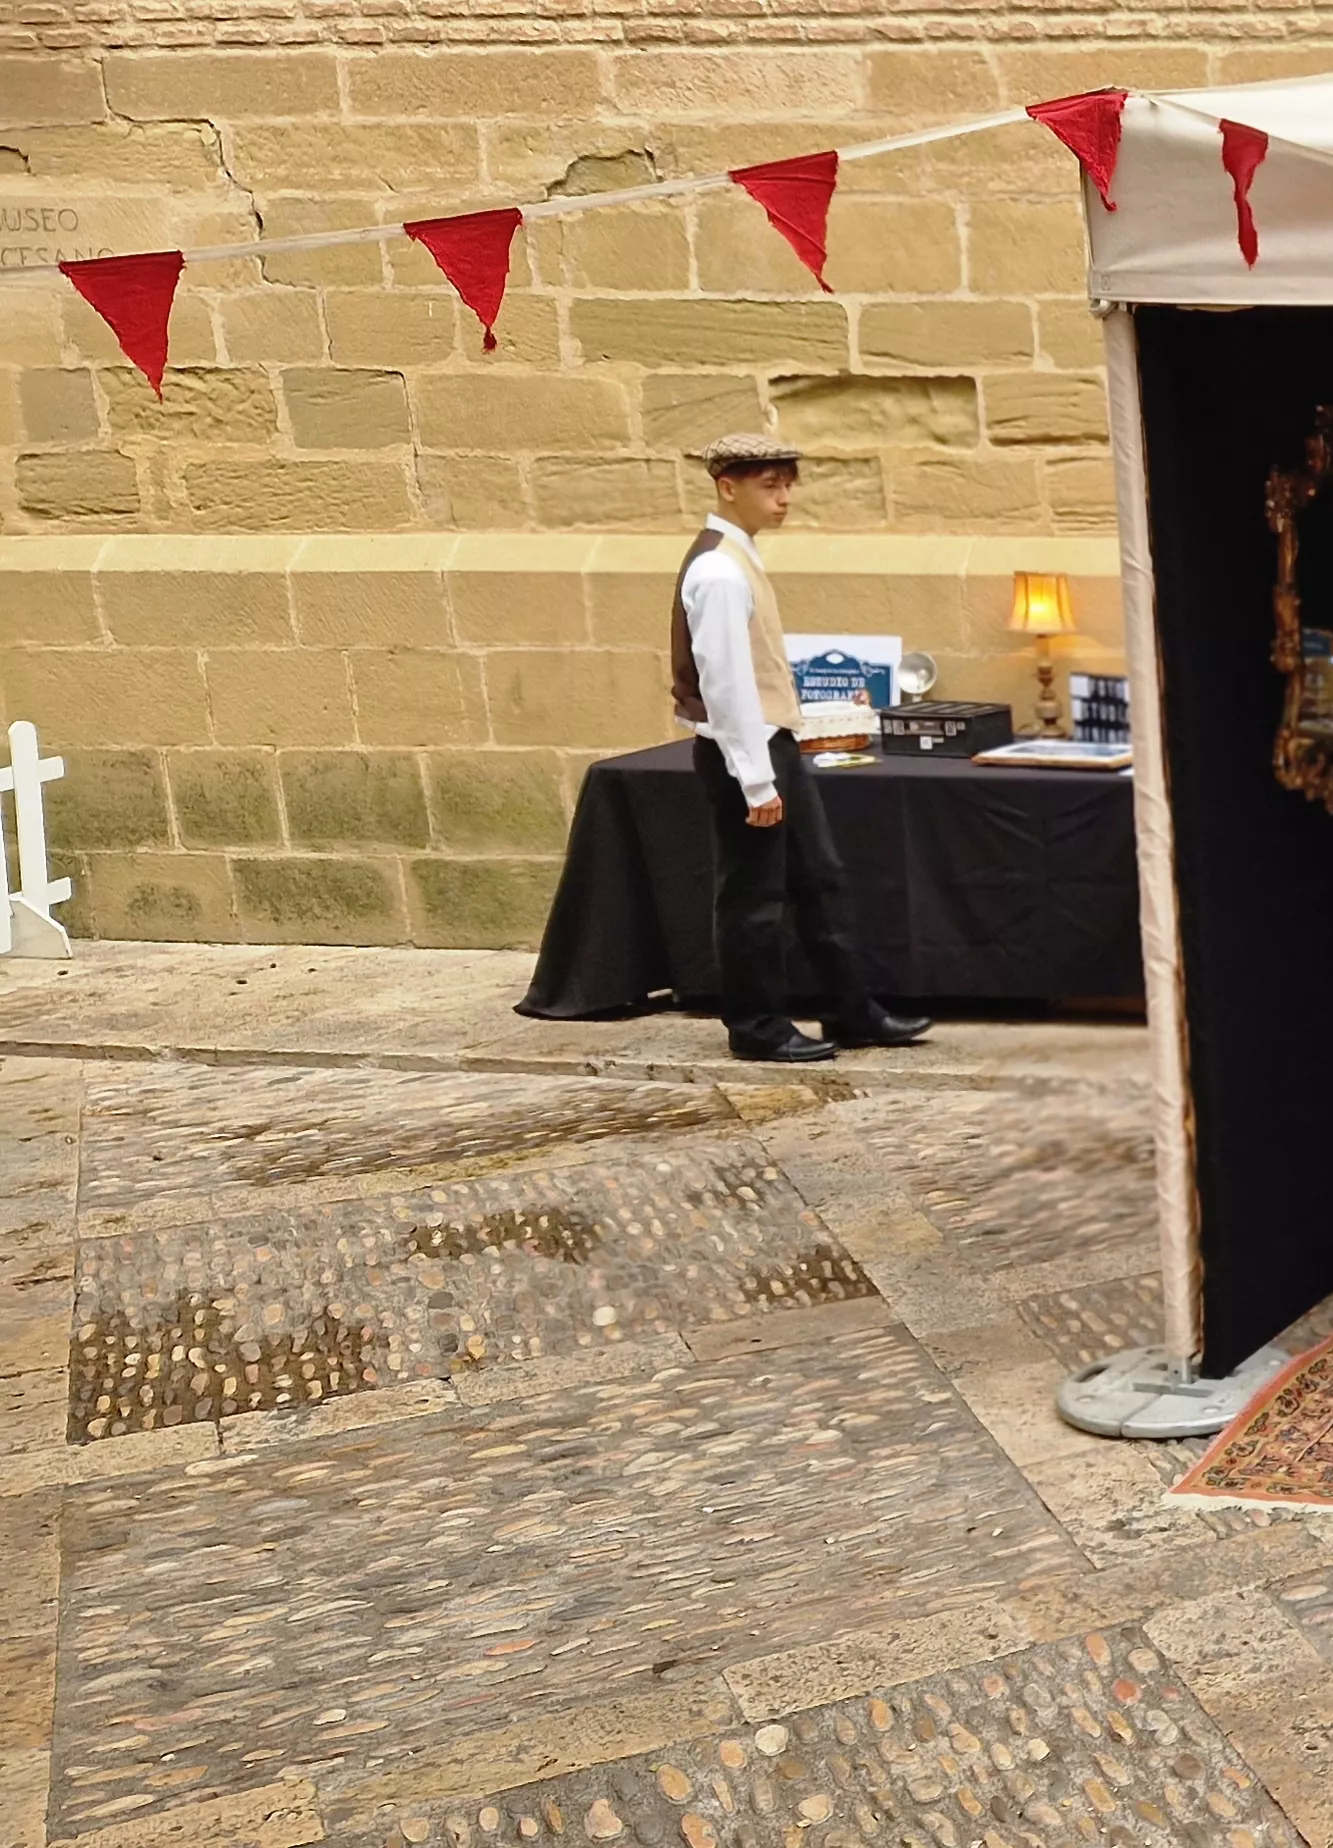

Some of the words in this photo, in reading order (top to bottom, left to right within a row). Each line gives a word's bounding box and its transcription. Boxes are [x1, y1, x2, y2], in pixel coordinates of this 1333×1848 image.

[0, 207, 79, 232] USEO
[803, 676, 849, 687] ESTUDIO
[851, 677, 866, 688] DE
[801, 689, 859, 701] FOTOGRAF
